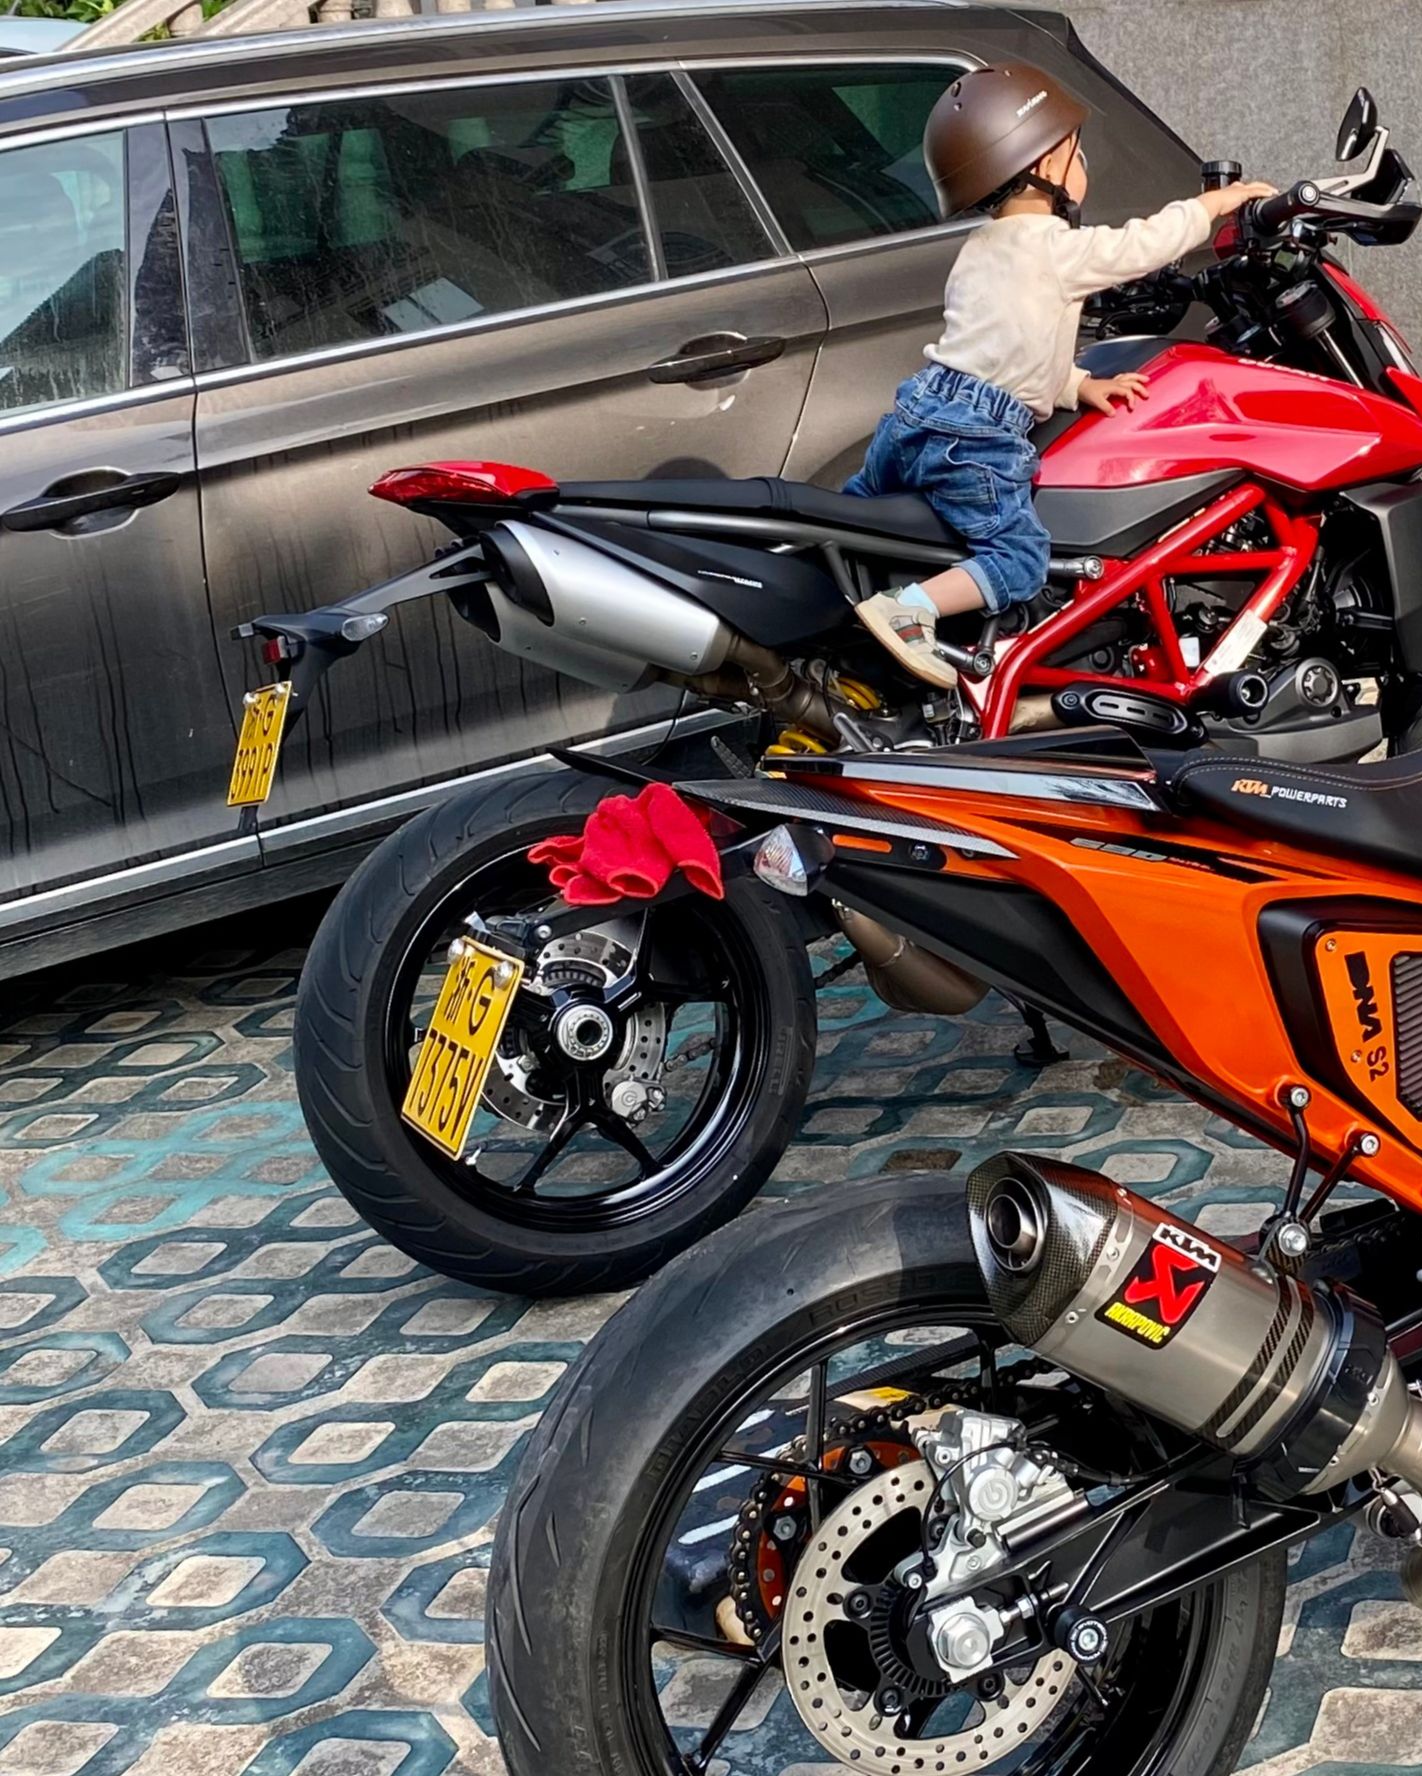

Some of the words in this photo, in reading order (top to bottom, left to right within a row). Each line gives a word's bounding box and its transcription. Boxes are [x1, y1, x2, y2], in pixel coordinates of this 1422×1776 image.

[1343, 951, 1383, 1044] DNA
[1366, 1045, 1390, 1083] S2
[409, 1027, 484, 1141] 7375V
[1159, 1226, 1218, 1269] KTM
